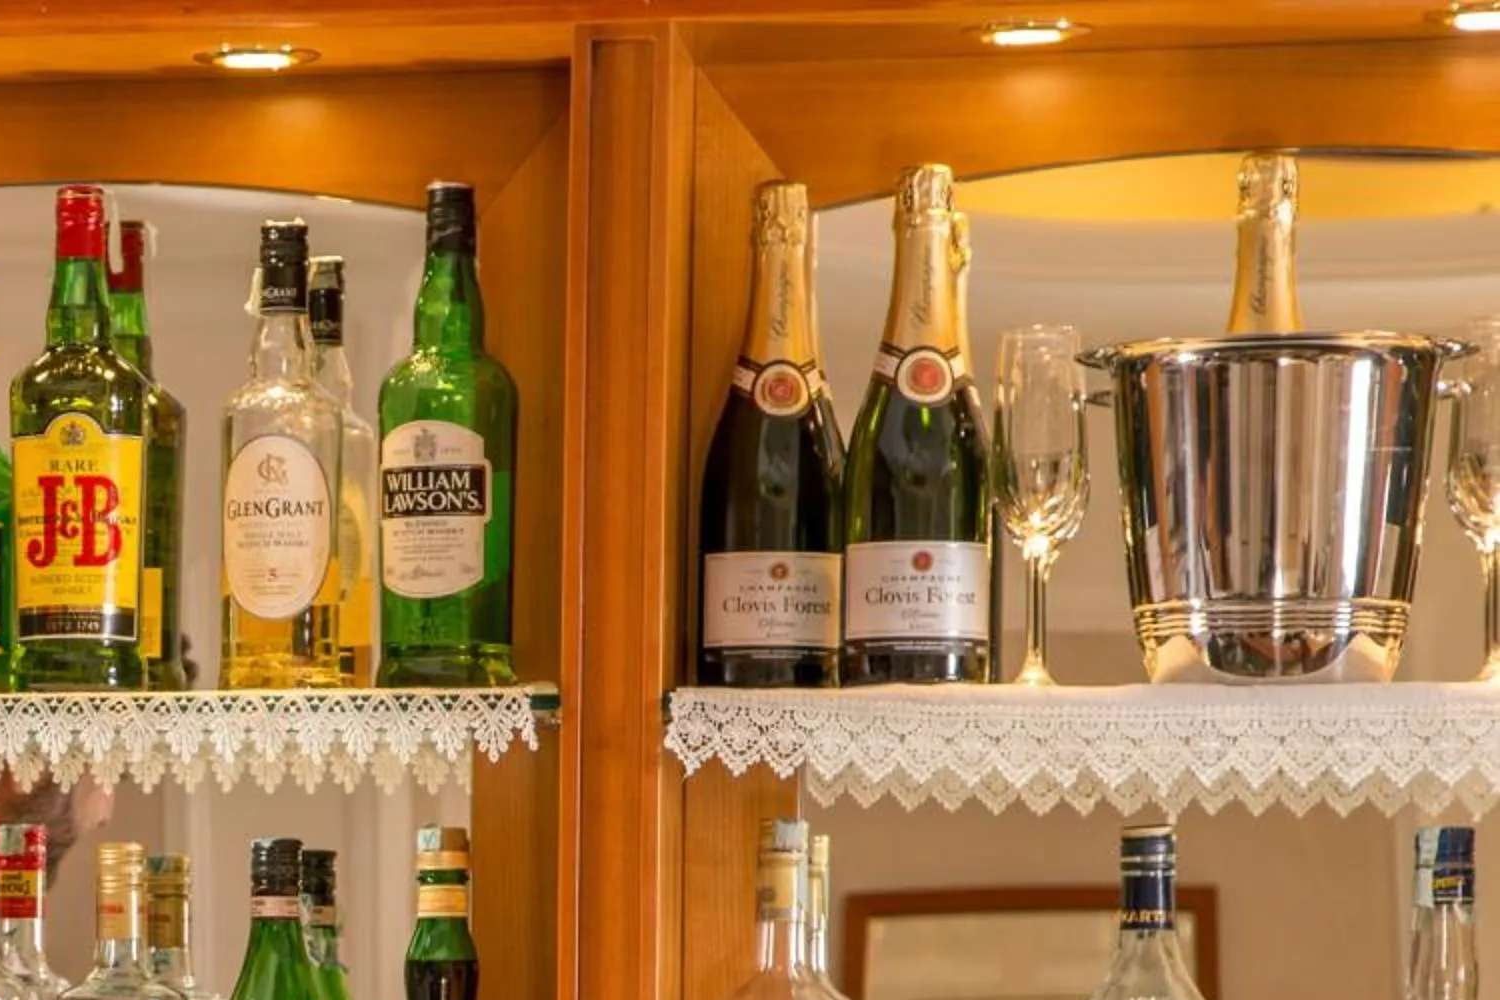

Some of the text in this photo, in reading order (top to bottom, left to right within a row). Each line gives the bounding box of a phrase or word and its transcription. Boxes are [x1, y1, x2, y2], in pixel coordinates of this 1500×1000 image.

[386, 471, 471, 492] WILLIAM
[385, 491, 479, 513] LAWSON'S
[26, 475, 122, 568] J&B
[722, 595, 831, 615] Clovis Forest
[865, 586, 919, 605] Clovis
